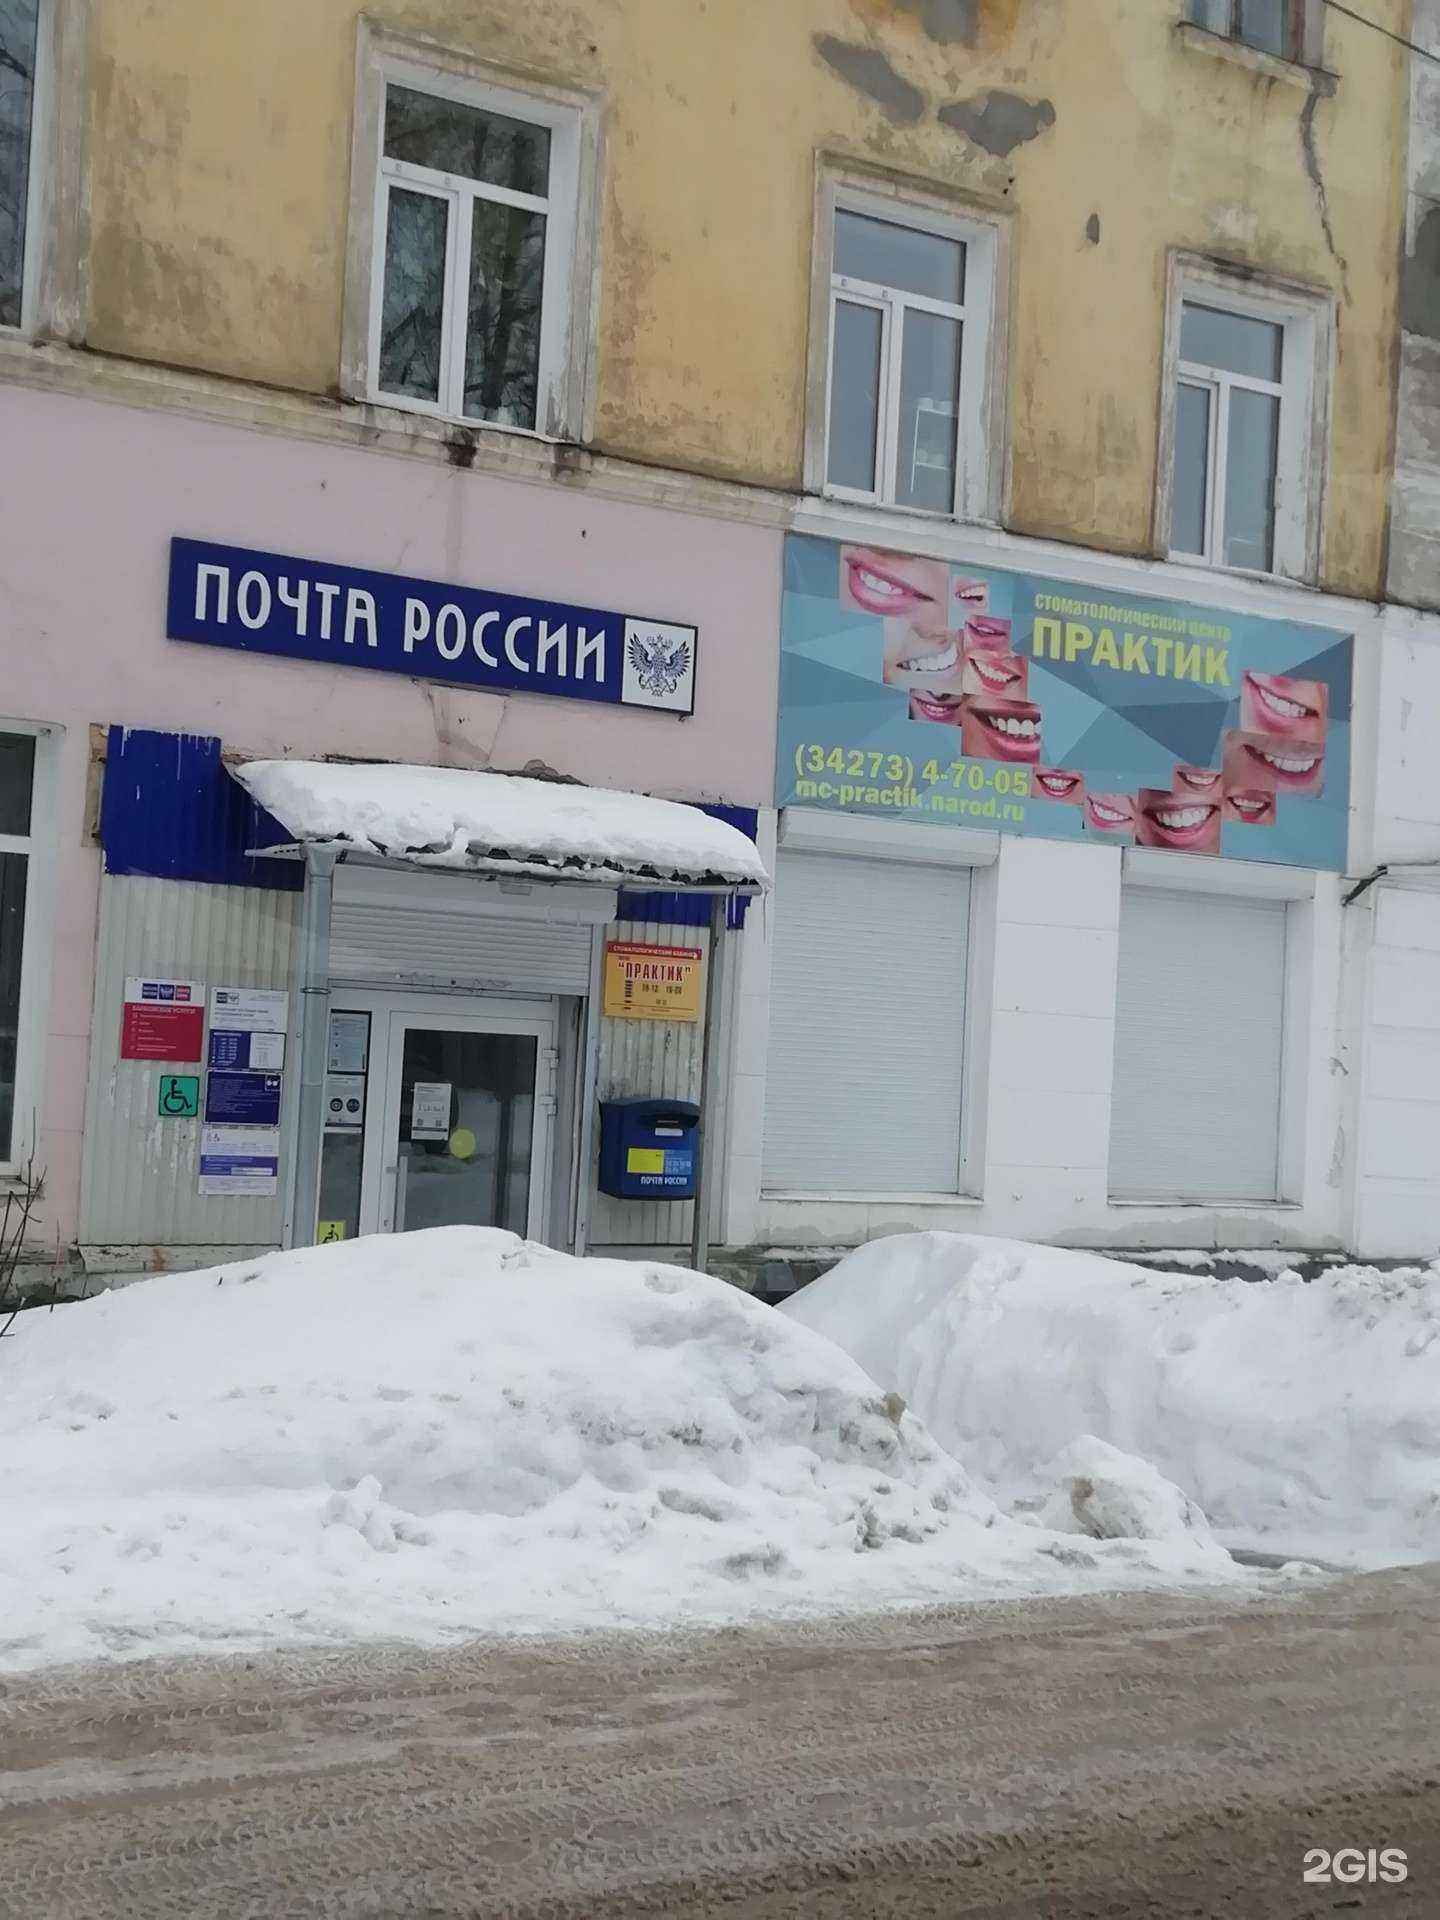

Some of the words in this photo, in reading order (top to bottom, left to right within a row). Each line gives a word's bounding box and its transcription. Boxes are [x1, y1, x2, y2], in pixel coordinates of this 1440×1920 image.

[195, 563, 379, 647] ПОЧТА
[403, 598, 606, 683] РОССИИ
[1032, 616, 1231, 687] ПРАКТИК
[795, 743, 914, 787] (34273)
[922, 759, 1029, 797] 4-70-05
[795, 780, 1025, 821] mc-practik.narod.ru
